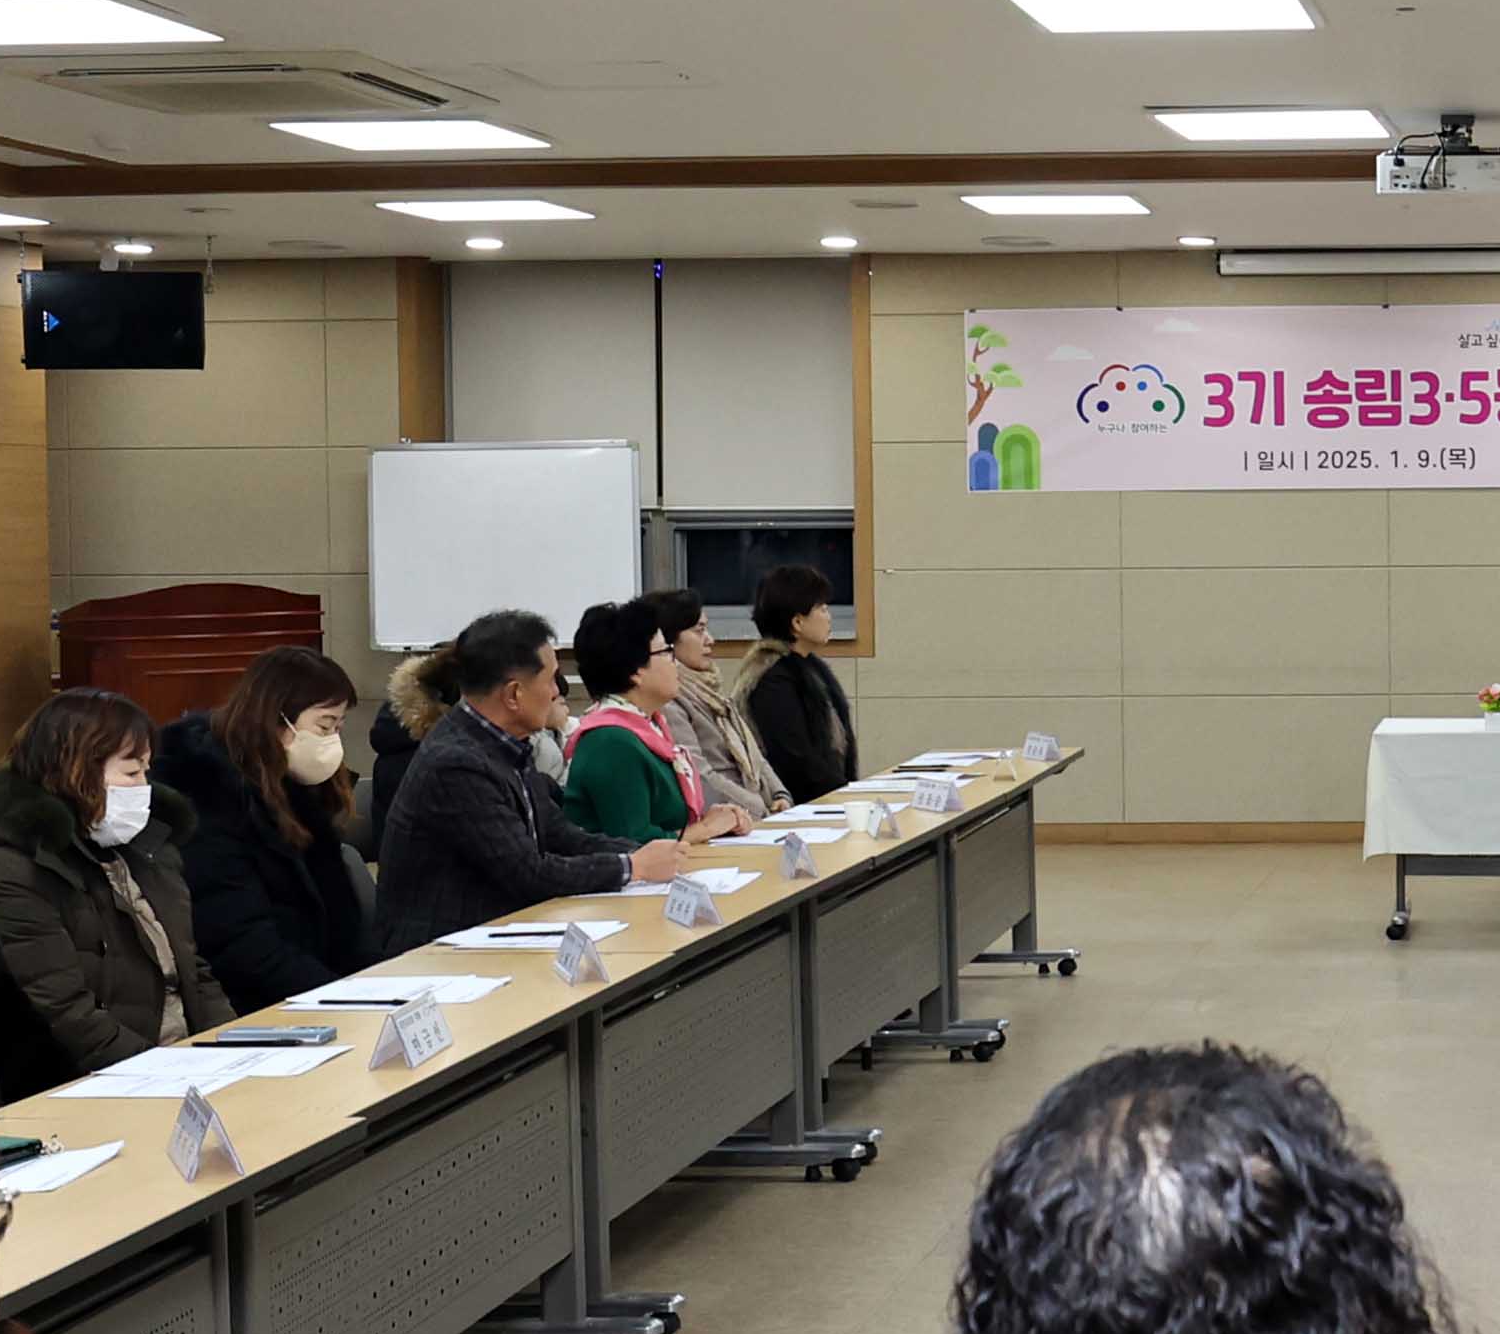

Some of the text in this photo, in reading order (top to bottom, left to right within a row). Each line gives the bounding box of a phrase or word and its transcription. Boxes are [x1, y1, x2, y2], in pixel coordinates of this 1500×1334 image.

[1457, 333, 1483, 348] 살고
[1202, 370, 1286, 427] 3기
[1257, 450, 1295, 470] 일시
[1317, 450, 1380, 470] 2025.
